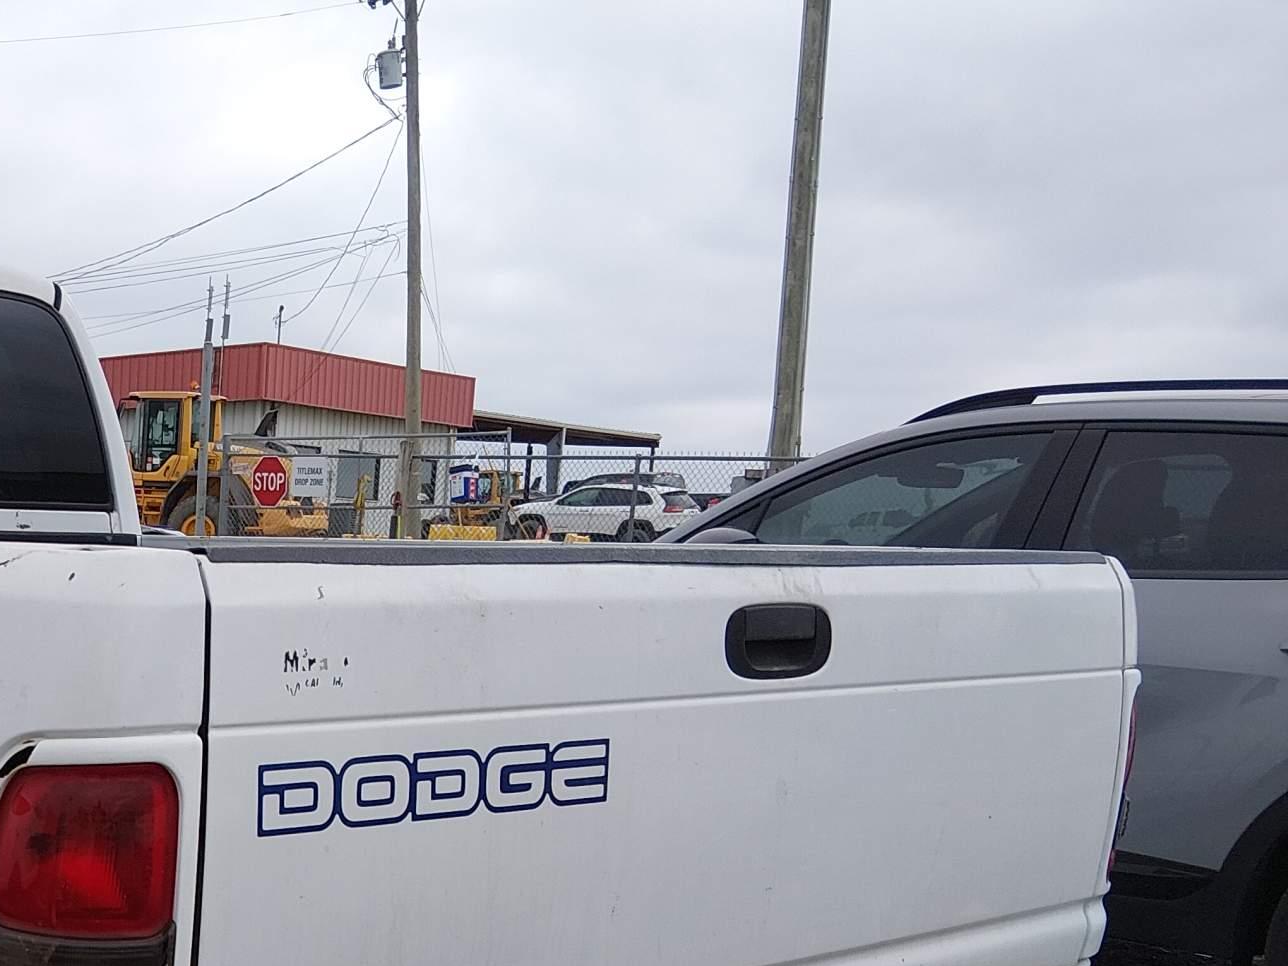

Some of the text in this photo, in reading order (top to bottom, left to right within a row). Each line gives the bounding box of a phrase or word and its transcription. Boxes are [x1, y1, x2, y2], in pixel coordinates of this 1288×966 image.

[296, 467, 323, 475] TITLEMAX
[253, 472, 285, 491] STOP
[294, 478, 324, 486] DROP ZONE
[257, 738, 610, 838] DODGE
